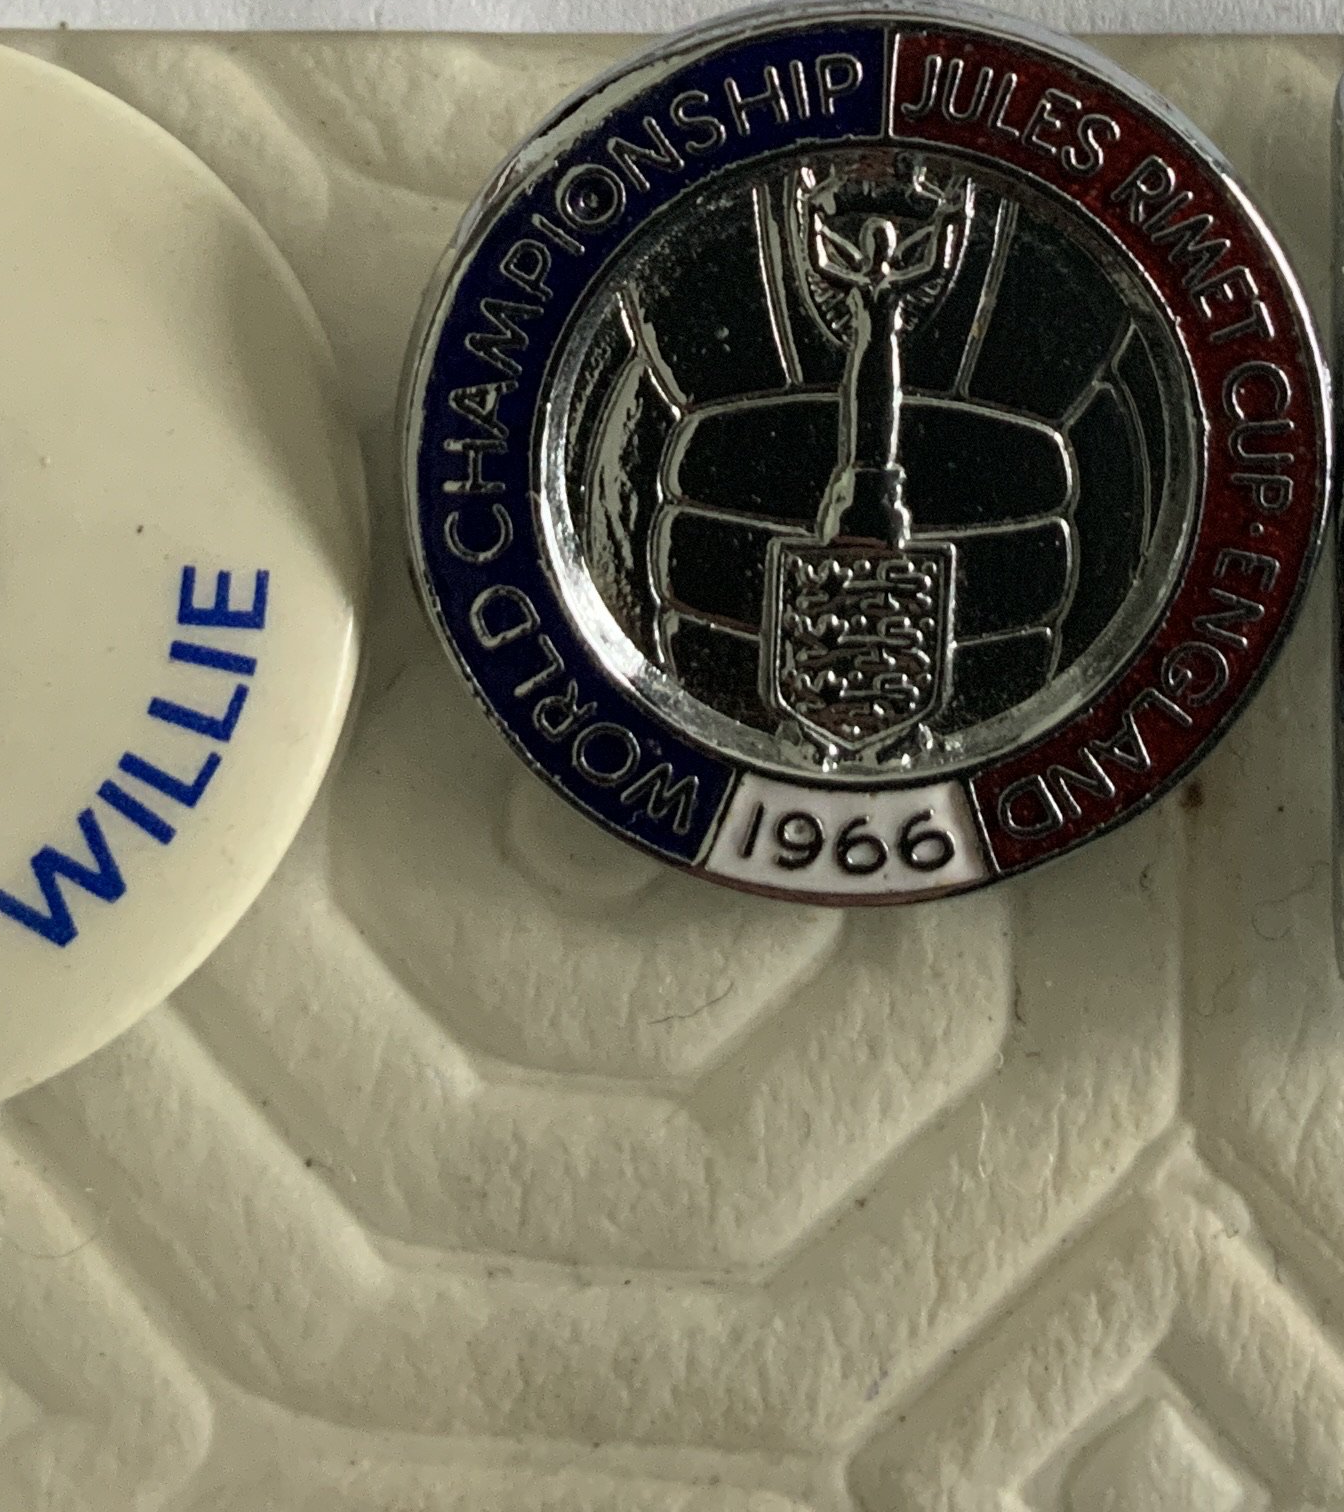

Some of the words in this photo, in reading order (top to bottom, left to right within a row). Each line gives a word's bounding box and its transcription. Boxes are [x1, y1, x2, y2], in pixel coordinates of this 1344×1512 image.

[899, 53, 1121, 174] JULES
[444, 51, 864, 564] CHAMPIONSHIP
[1110, 155, 1275, 348] RIMET
[1221, 361, 1294, 513] CUP
[468, 586, 699, 837] WORLD
[997, 550, 1277, 842] ENGLAND
[738, 802, 957, 876] 1966
